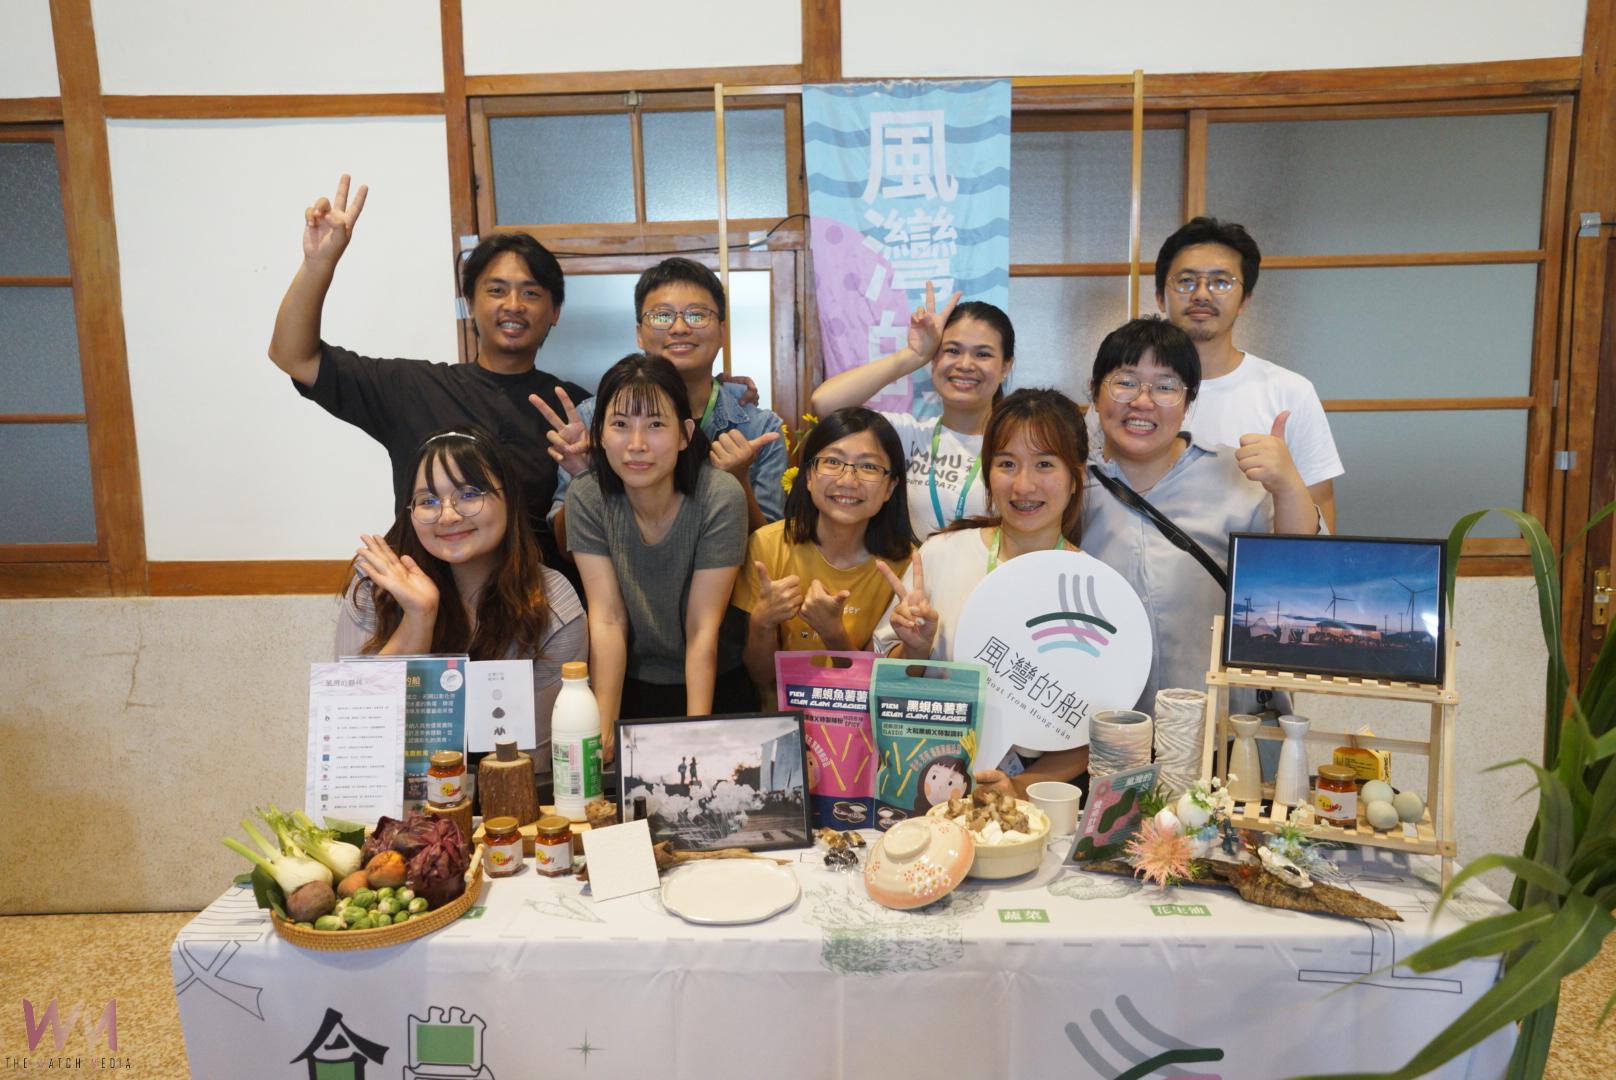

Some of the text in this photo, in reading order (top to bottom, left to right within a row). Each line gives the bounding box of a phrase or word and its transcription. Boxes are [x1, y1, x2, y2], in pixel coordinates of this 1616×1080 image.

[973, 636, 1089, 729] 風灣的船
[810, 700, 830, 708] CLAM
[832, 702, 867, 710] CRACKER
[1006, 691, 1027, 711] from
[905, 712, 928, 720] CLAM
[930, 714, 967, 722] CRACKER
